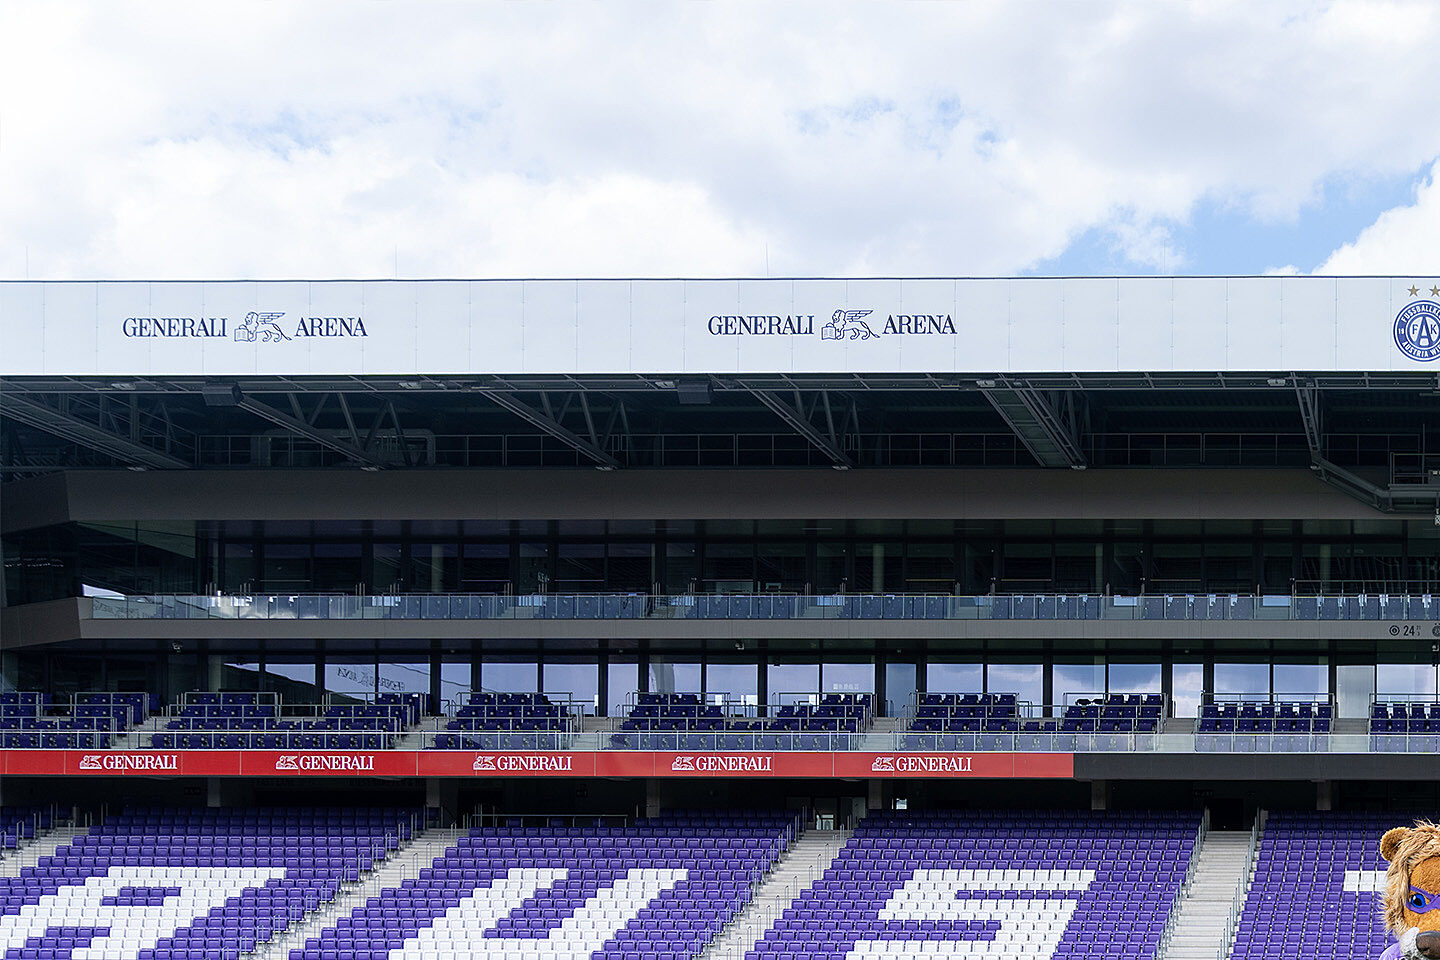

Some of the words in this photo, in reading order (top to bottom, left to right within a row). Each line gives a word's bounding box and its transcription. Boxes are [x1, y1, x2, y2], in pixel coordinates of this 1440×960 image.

[123, 318, 227, 337] GENERALI
[294, 317, 368, 337] ARENA
[708, 315, 814, 335] GENERALI
[882, 315, 957, 334] ARENA
[1402, 341, 1429, 358] AUSTRIA
[1403, 625, 1415, 636] 24
[103, 755, 178, 770] GENERALI
[299, 755, 375, 770] GENERALI
[497, 755, 573, 771] GENERALI
[696, 756, 772, 772] GENERALI
[896, 756, 973, 772] GENERALI
